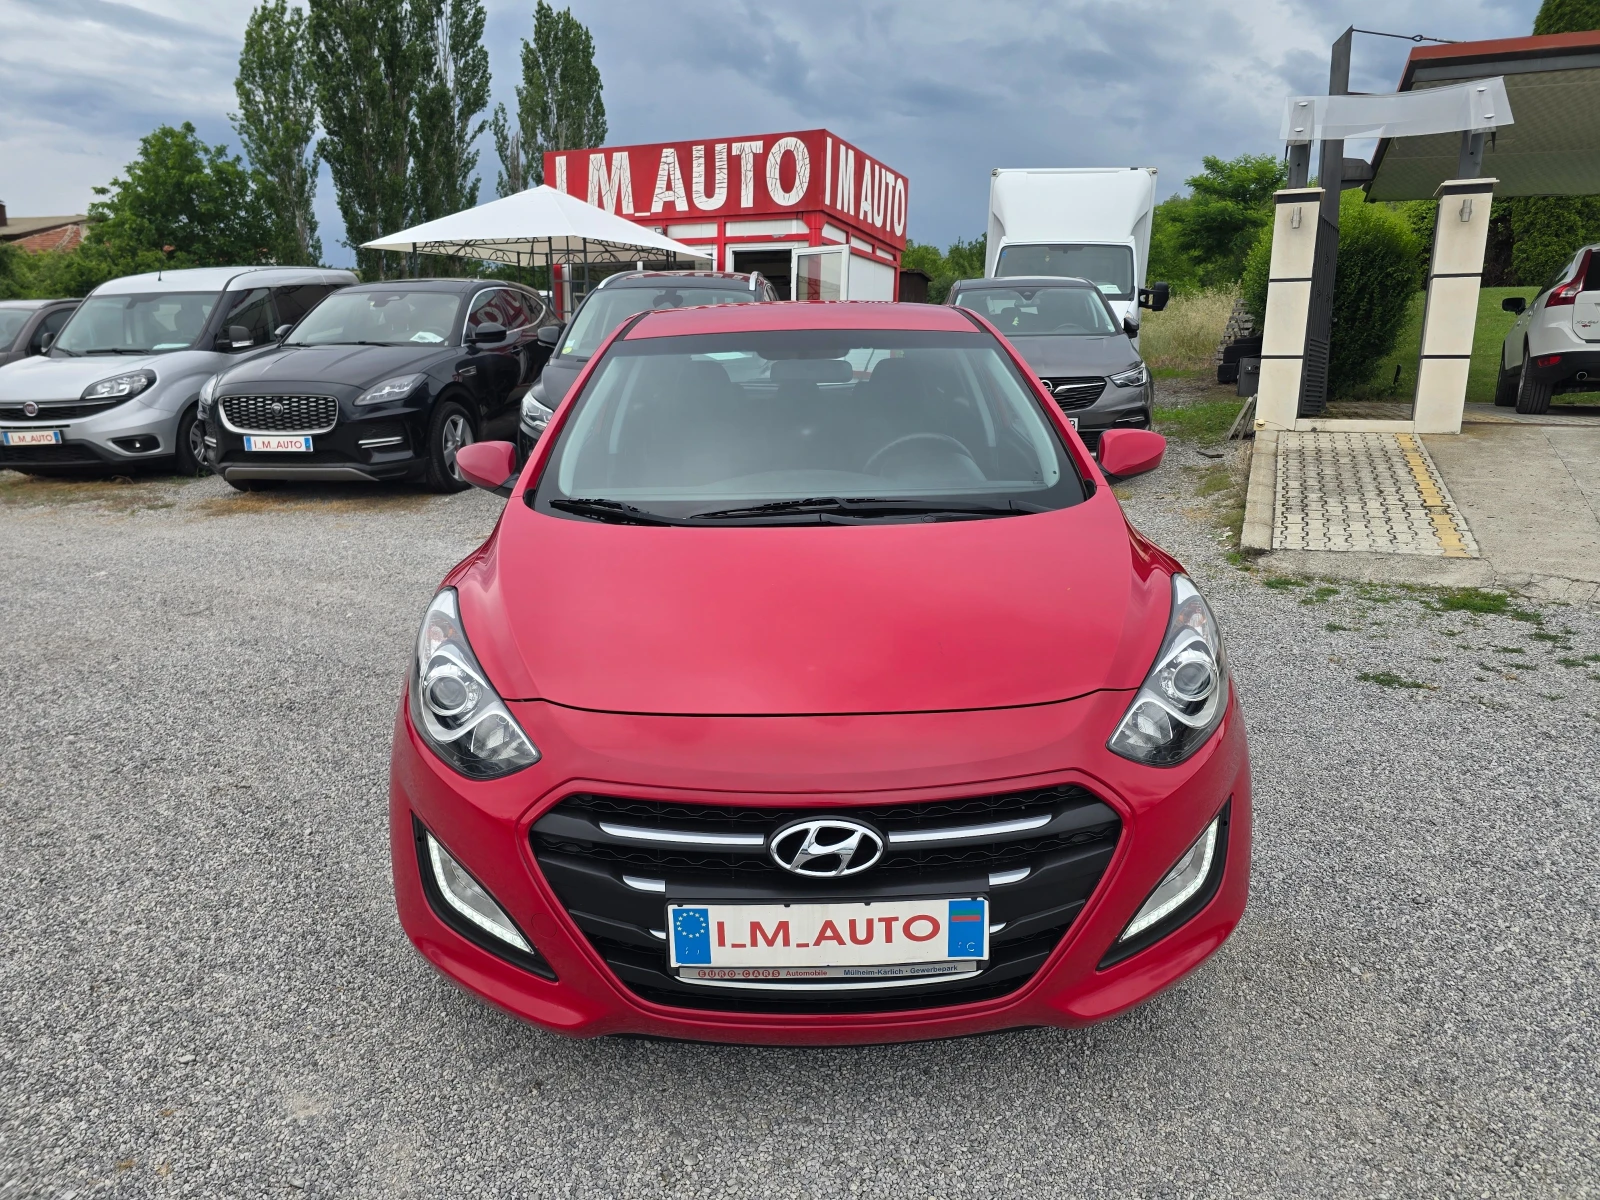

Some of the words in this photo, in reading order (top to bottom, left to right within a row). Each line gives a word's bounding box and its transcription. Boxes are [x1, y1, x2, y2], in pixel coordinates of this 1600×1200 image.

[859, 158, 905, 237] AUTO
[697, 969, 781, 979] EURO-CARS
[785, 969, 828, 978] Automobile
[910, 964, 958, 975] Gewerbepark
